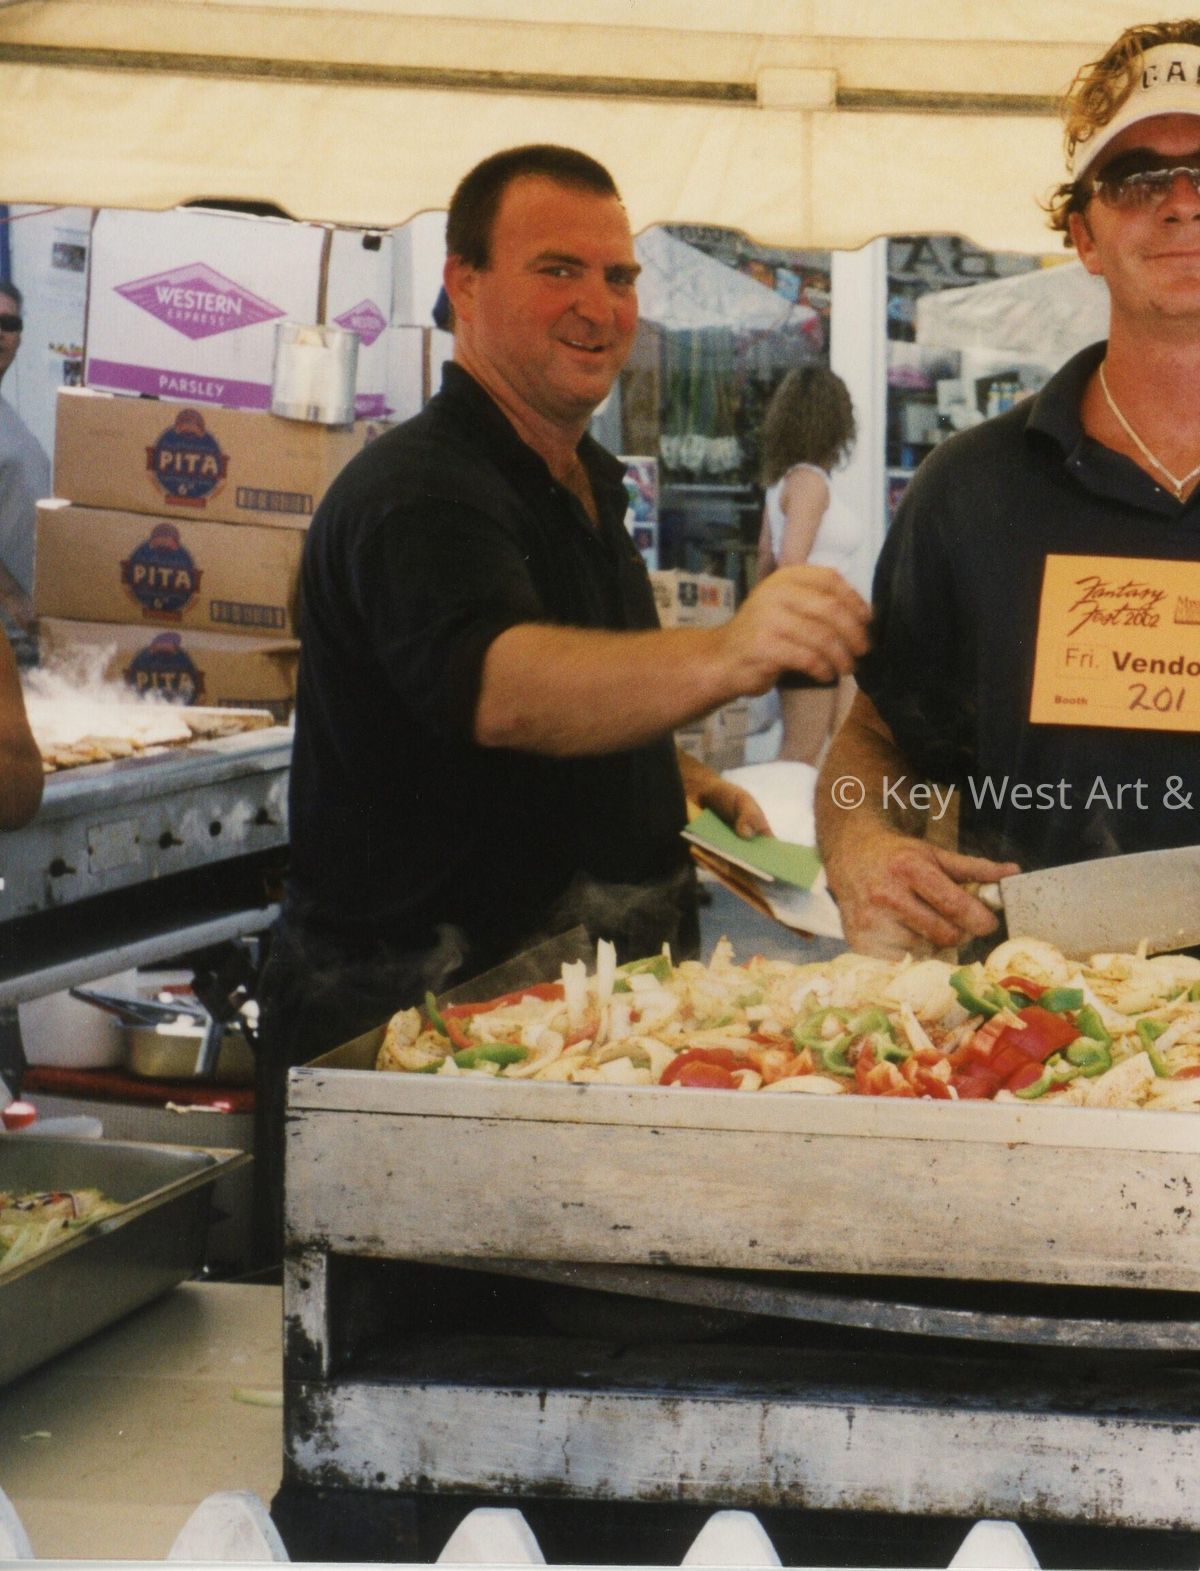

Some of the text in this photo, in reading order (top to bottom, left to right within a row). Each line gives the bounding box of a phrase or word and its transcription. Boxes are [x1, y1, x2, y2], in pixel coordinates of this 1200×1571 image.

[155, 286, 242, 315] WESTERN
[167, 308, 226, 327] EXPRESS
[158, 375, 225, 397] PARSLEY
[159, 451, 218, 475] PITA
[133, 564, 191, 589] PITA
[1068, 576, 1168, 612] Fantasy
[1066, 600, 1128, 637] Fest
[1124, 611, 1160, 628] 2002
[1065, 648, 1099, 668] Fri.
[136, 671, 194, 697] PITA
[1054, 695, 1088, 706] Booth
[1128, 683, 1186, 712] 201
